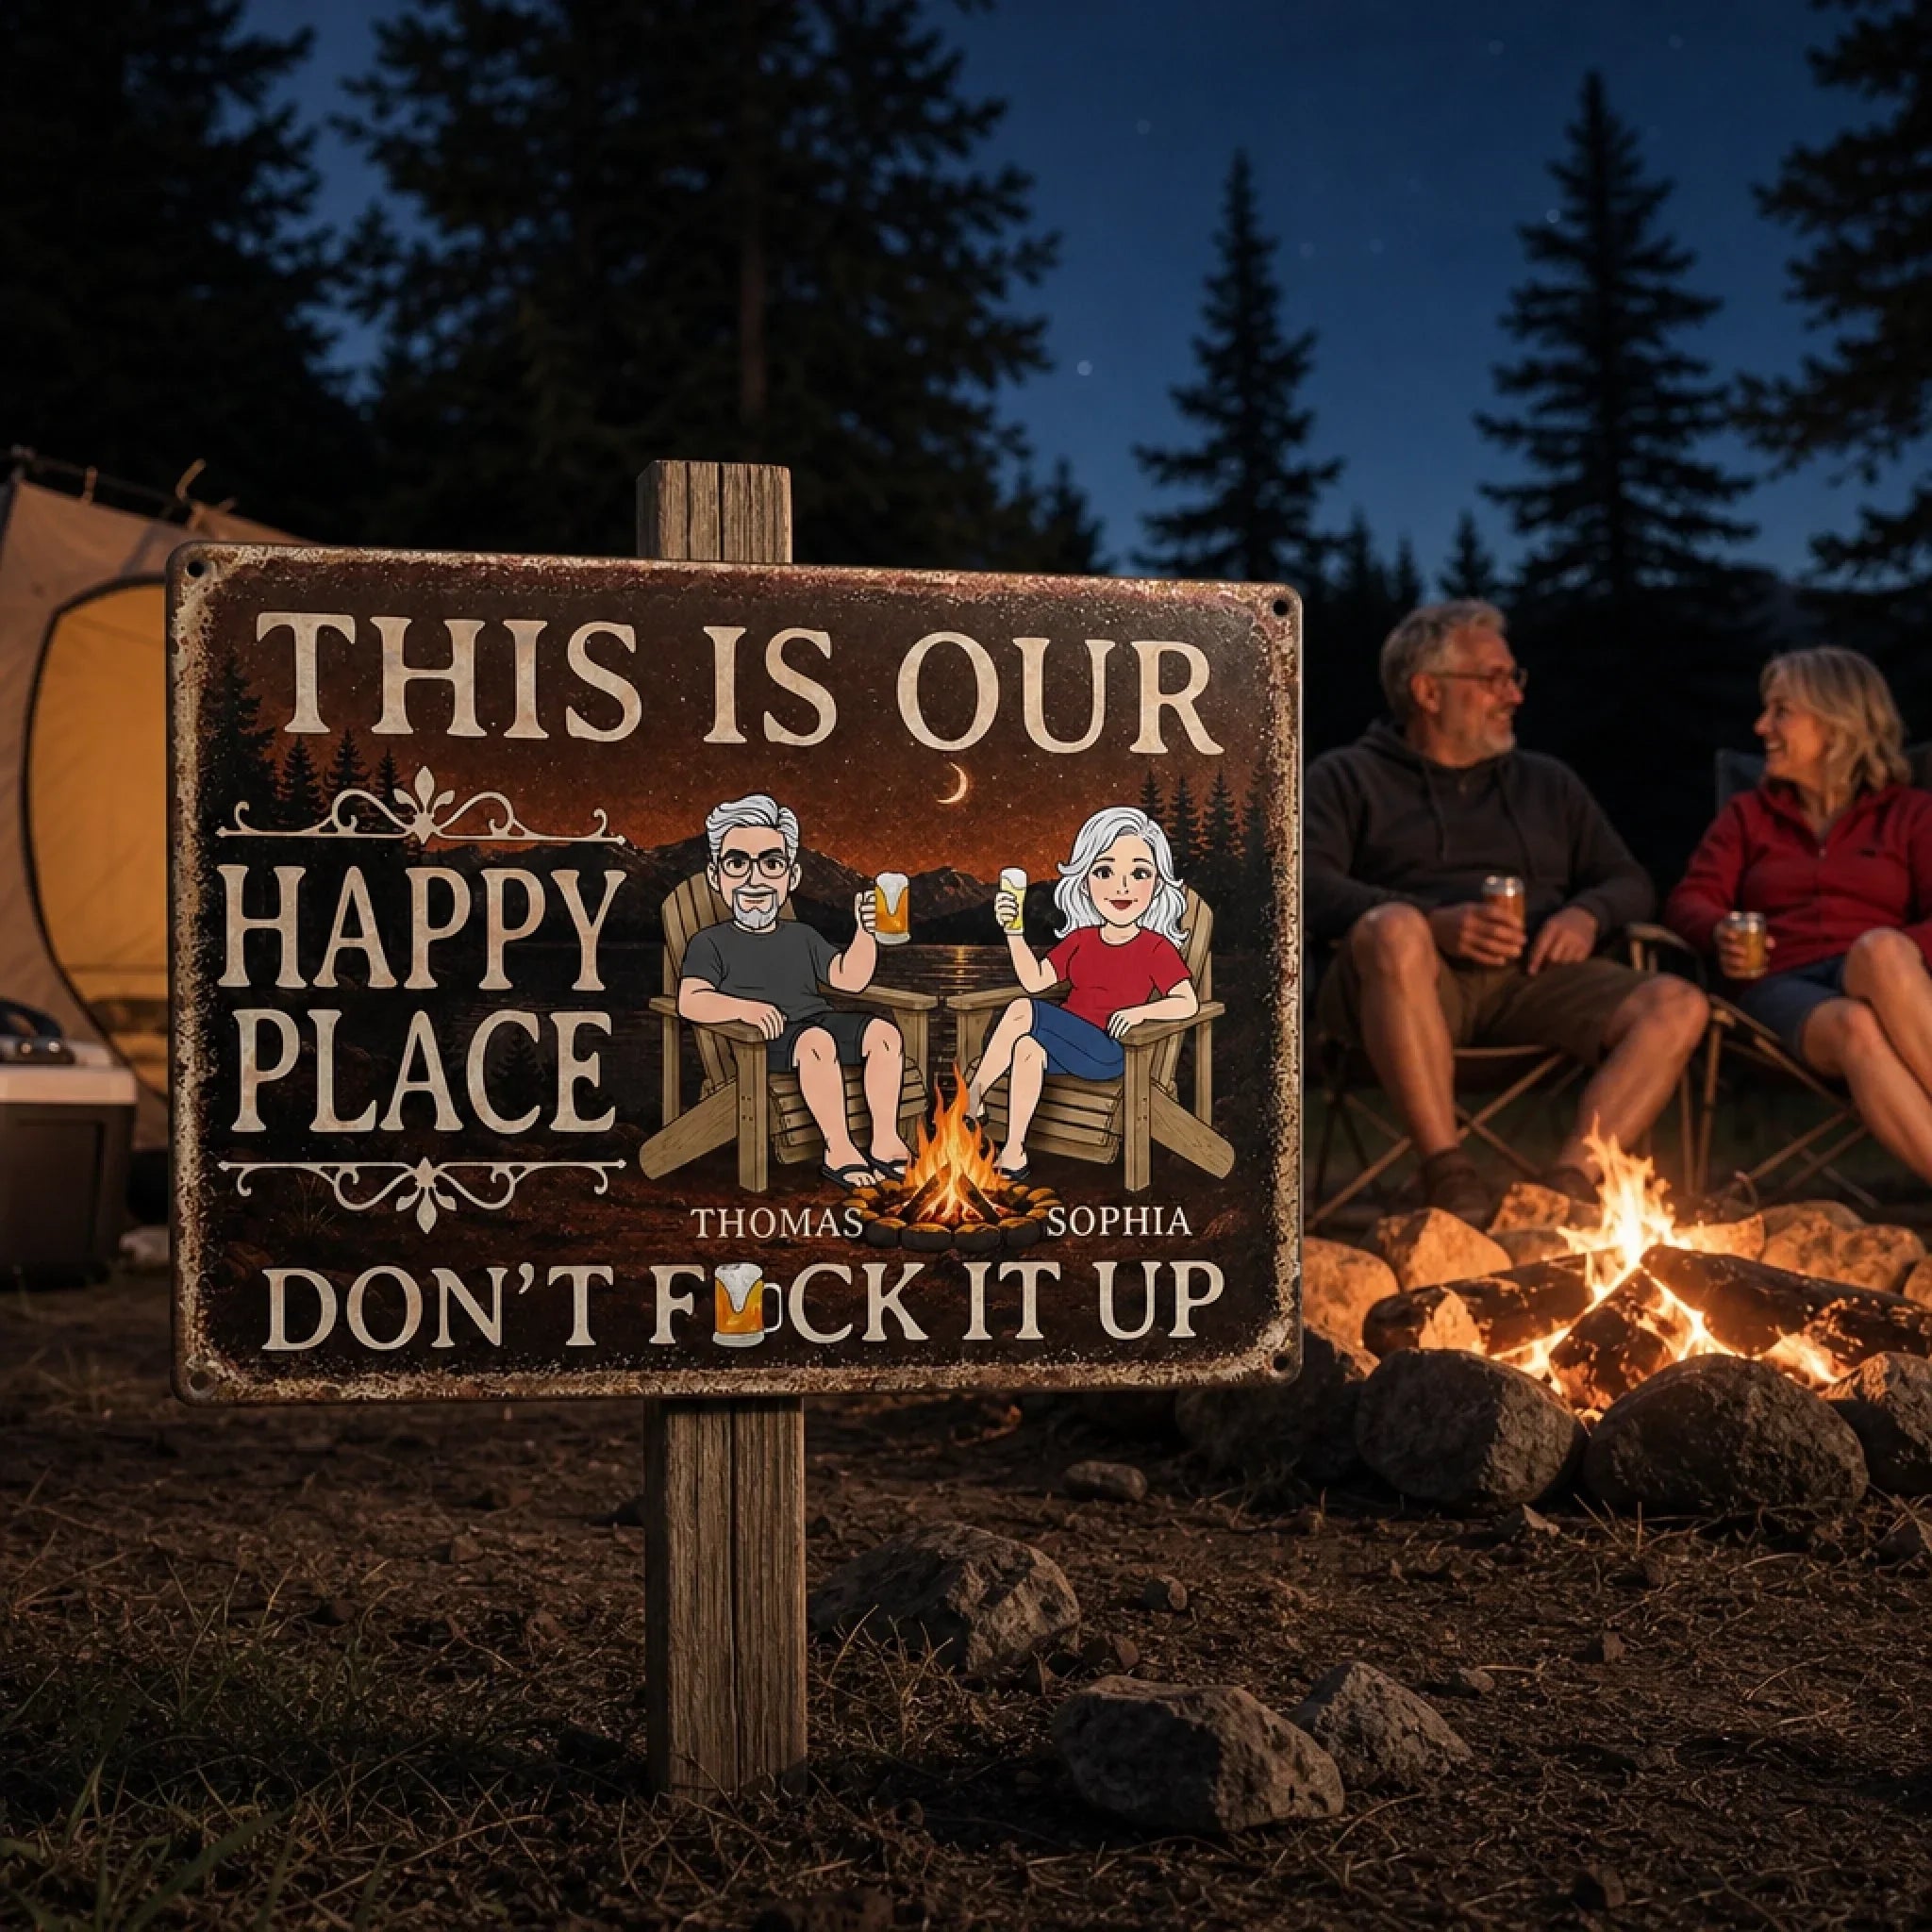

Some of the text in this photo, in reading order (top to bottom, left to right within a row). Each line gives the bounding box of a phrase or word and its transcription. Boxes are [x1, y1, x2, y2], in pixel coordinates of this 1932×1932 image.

[256, 611, 1225, 757] THIS IS OUR
[216, 864, 628, 992] HAPPY
[231, 1008, 616, 1136] PLACE
[690, 1206, 863, 1240] THOMAS
[1046, 1204, 1192, 1238] SOPHIA
[261, 1260, 1224, 1351] DON’T FCK IT UP
